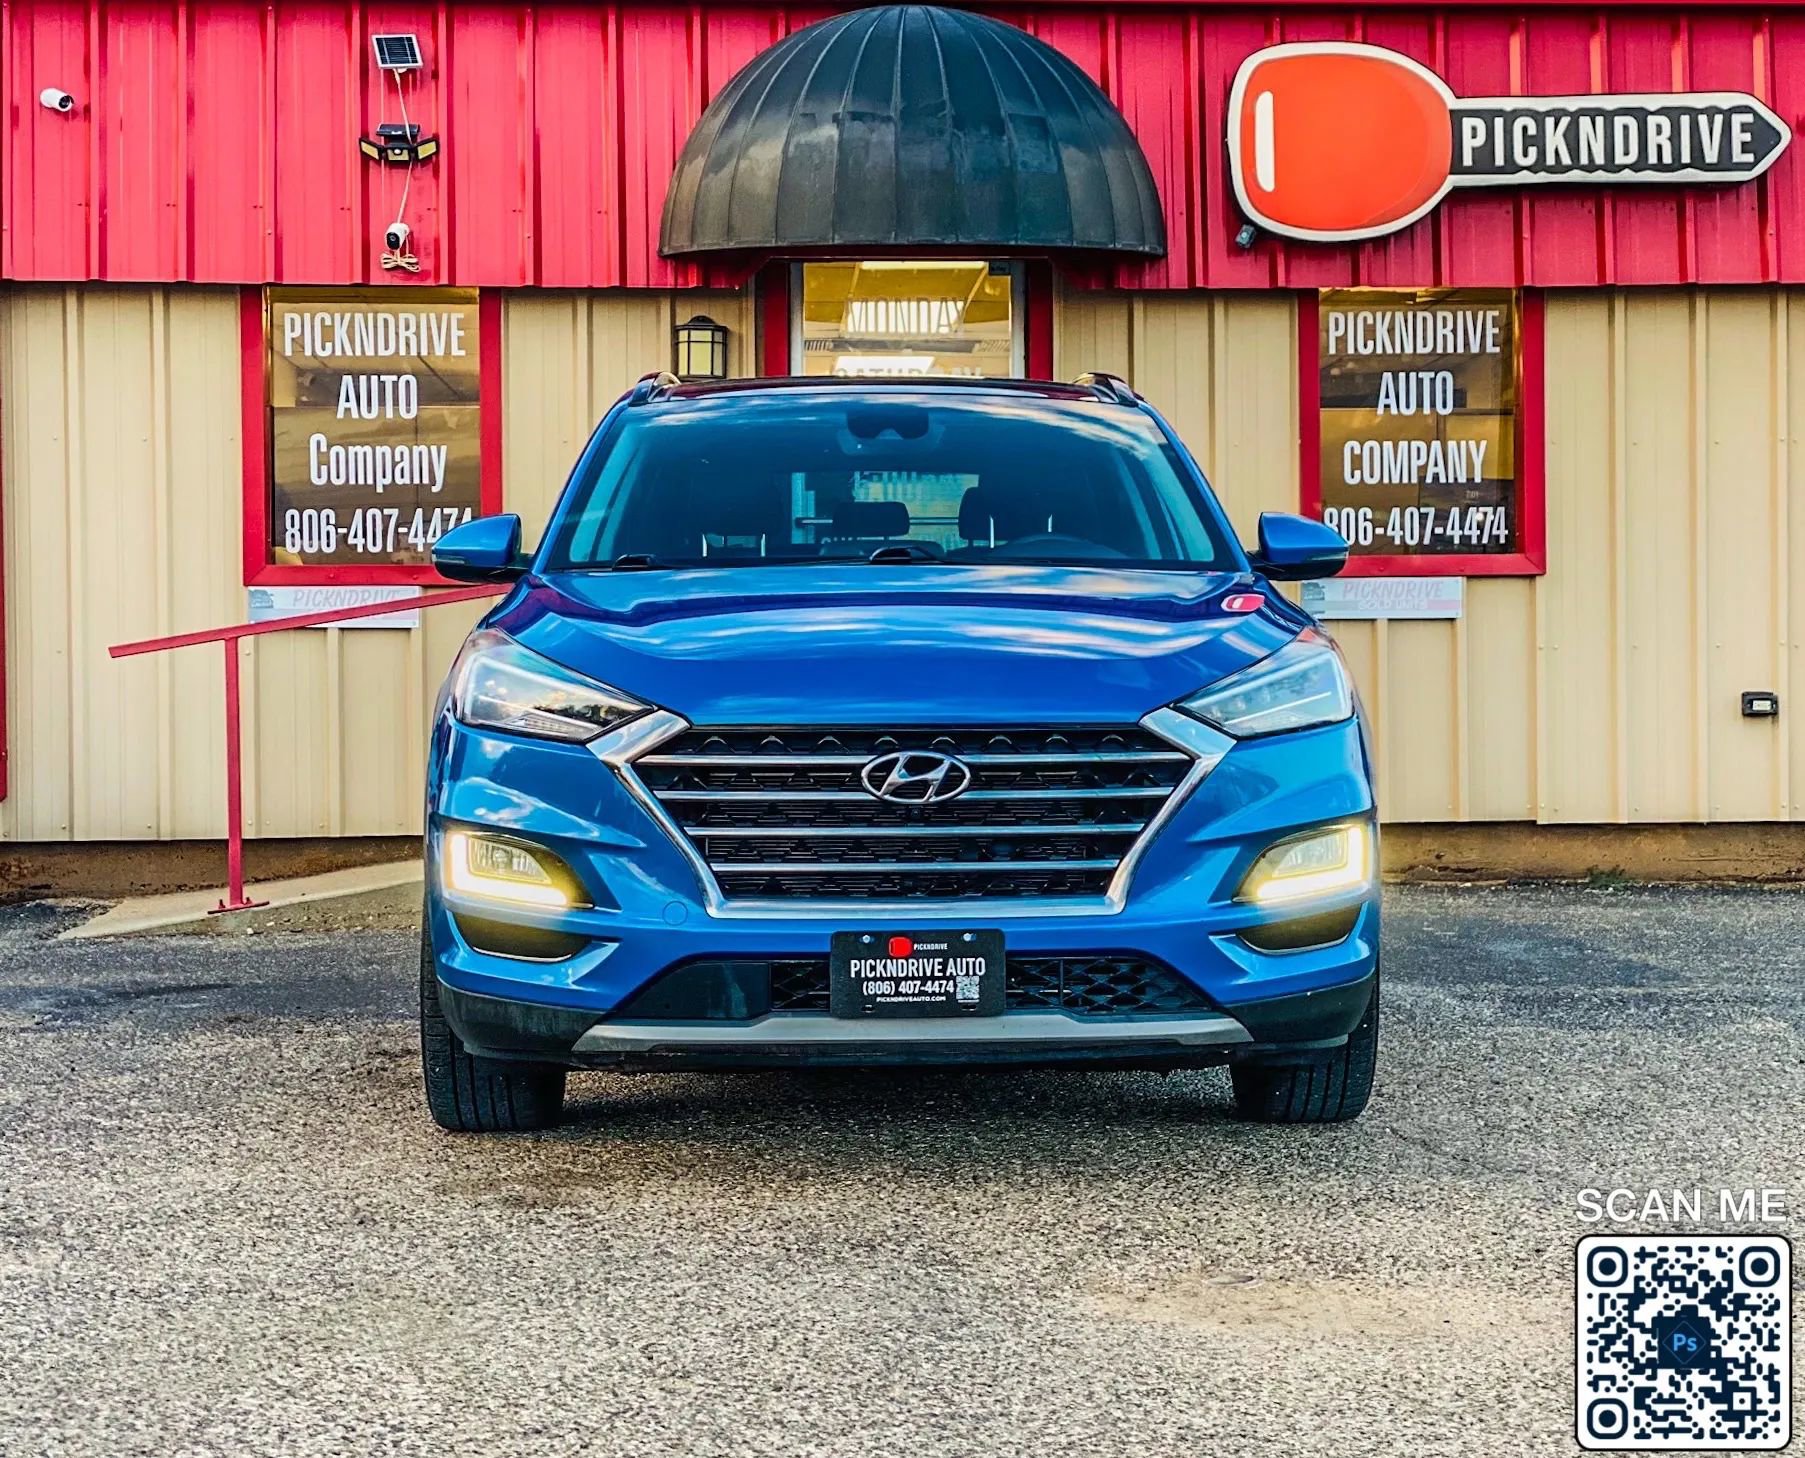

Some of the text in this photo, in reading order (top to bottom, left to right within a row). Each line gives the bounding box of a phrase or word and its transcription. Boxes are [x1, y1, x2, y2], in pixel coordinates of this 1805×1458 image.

[1461, 113, 1755, 167] PICKNDRIVE
[283, 312, 466, 357] PICKNDRIVE
[846, 297, 967, 336] MONDAY
[1327, 310, 1501, 355] PICKNDRIVE
[336, 374, 418, 420] AUTO
[1376, 371, 1454, 416] AUTO
[309, 433, 448, 493] Company
[1343, 440, 1488, 484] COMPANY
[1342, 580, 1444, 599] PICKNDRIVE
[850, 957, 986, 978] PICKNDRIVE AUTO
[913, 943, 948, 951] PICKNDRIVE
[862, 980, 955, 996] (806) 407-4474
